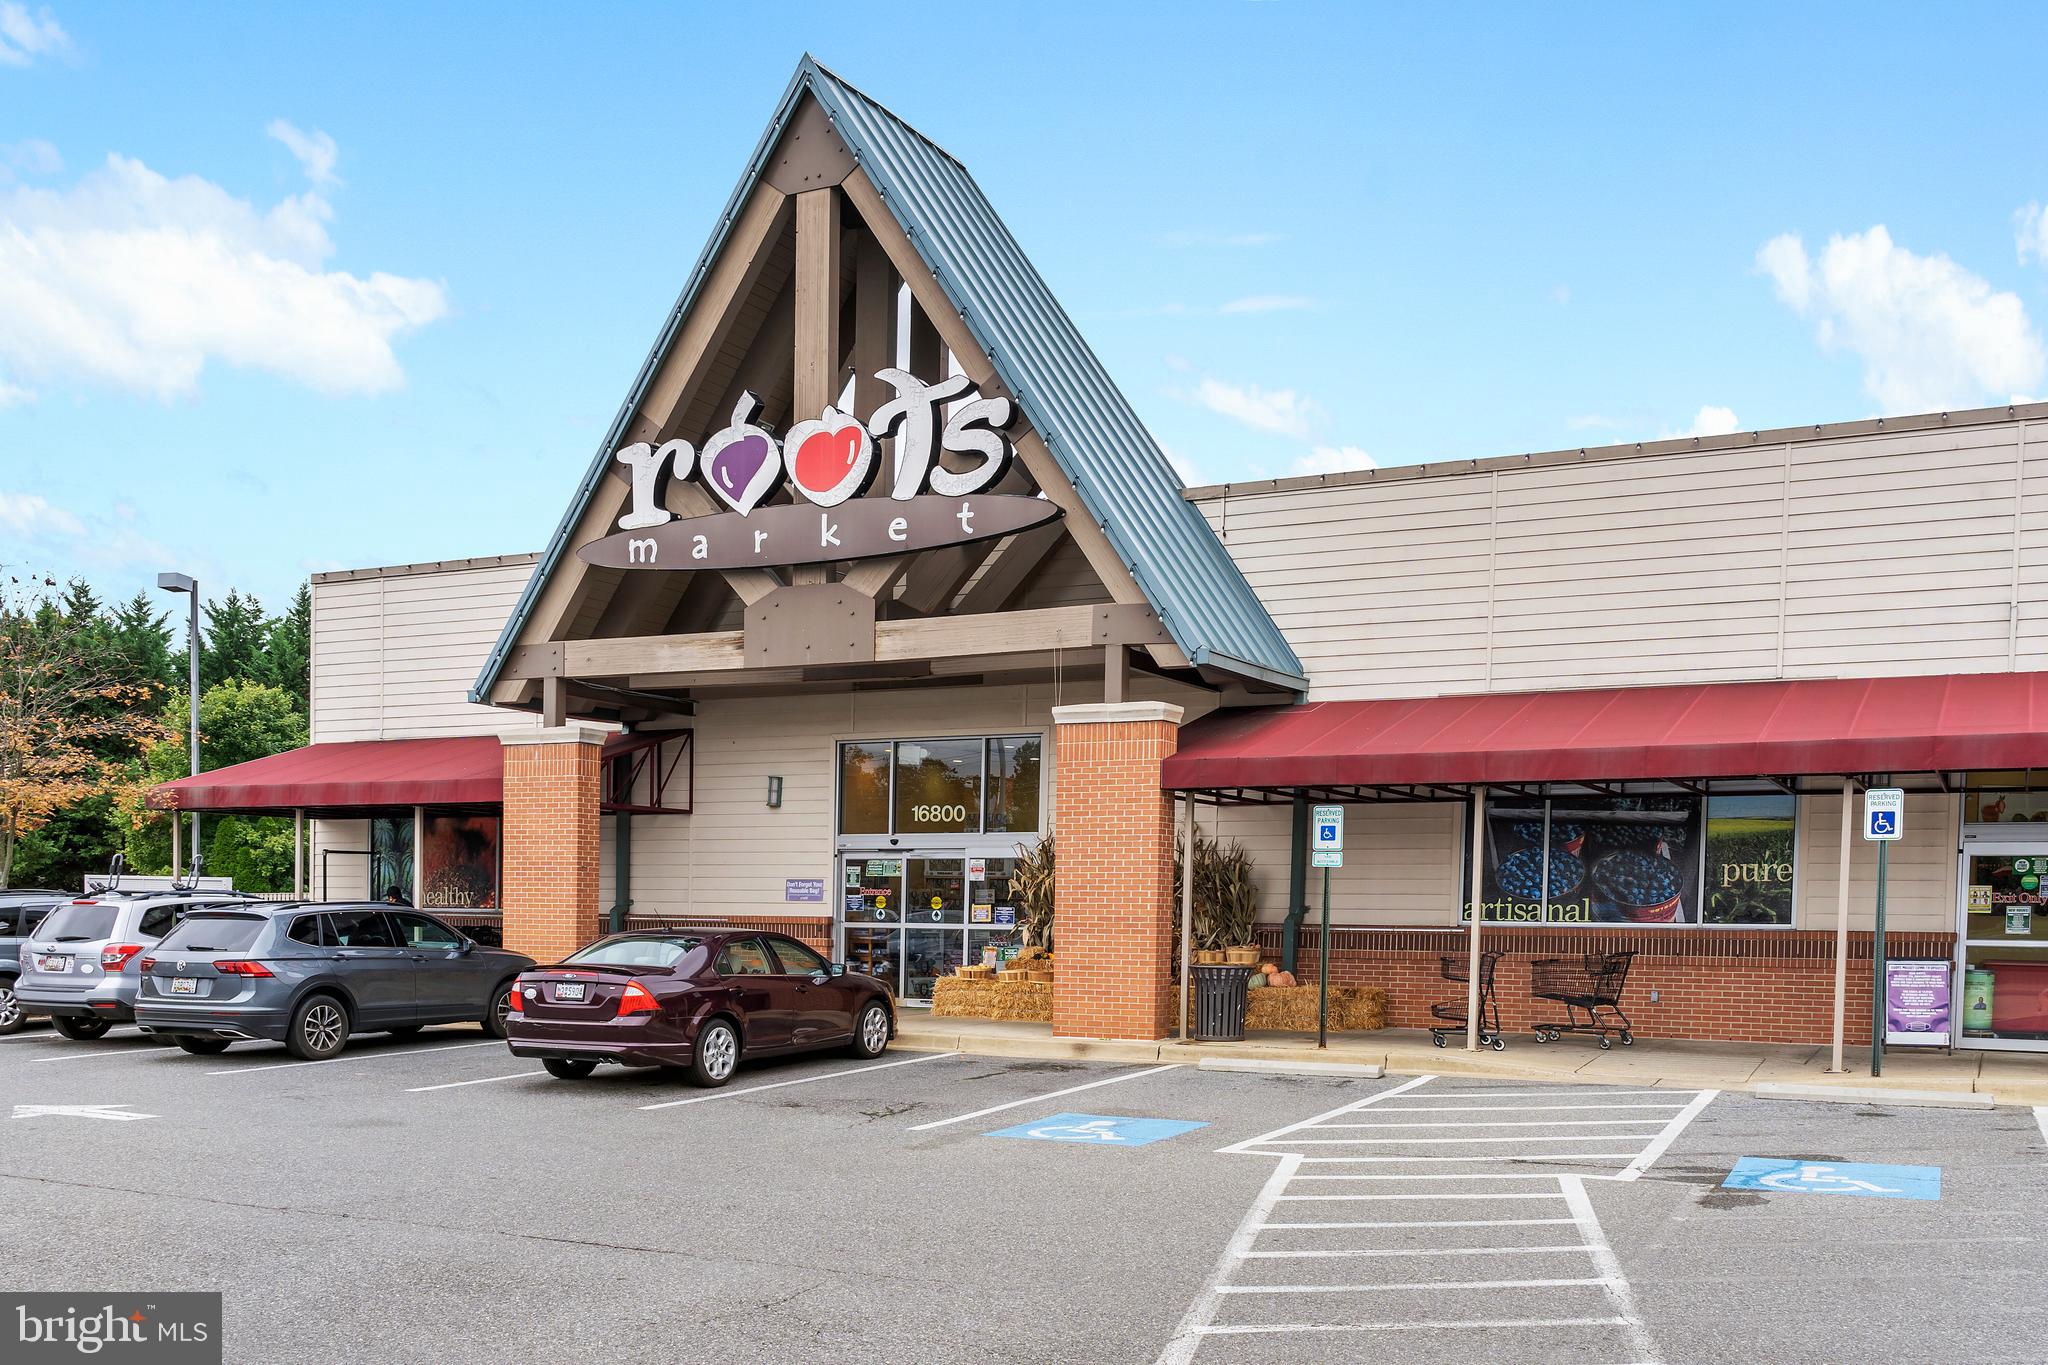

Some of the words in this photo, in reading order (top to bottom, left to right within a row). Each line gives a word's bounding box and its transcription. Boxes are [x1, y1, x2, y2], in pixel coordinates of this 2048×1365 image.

[616, 367, 1016, 530] roots
[629, 502, 975, 563] market
[912, 804, 966, 823] 16800
[1721, 863, 1793, 888] pure
[860, 886, 892, 896] Entrance
[1992, 892, 2017, 903] Exit
[2018, 891, 2048, 906] Only
